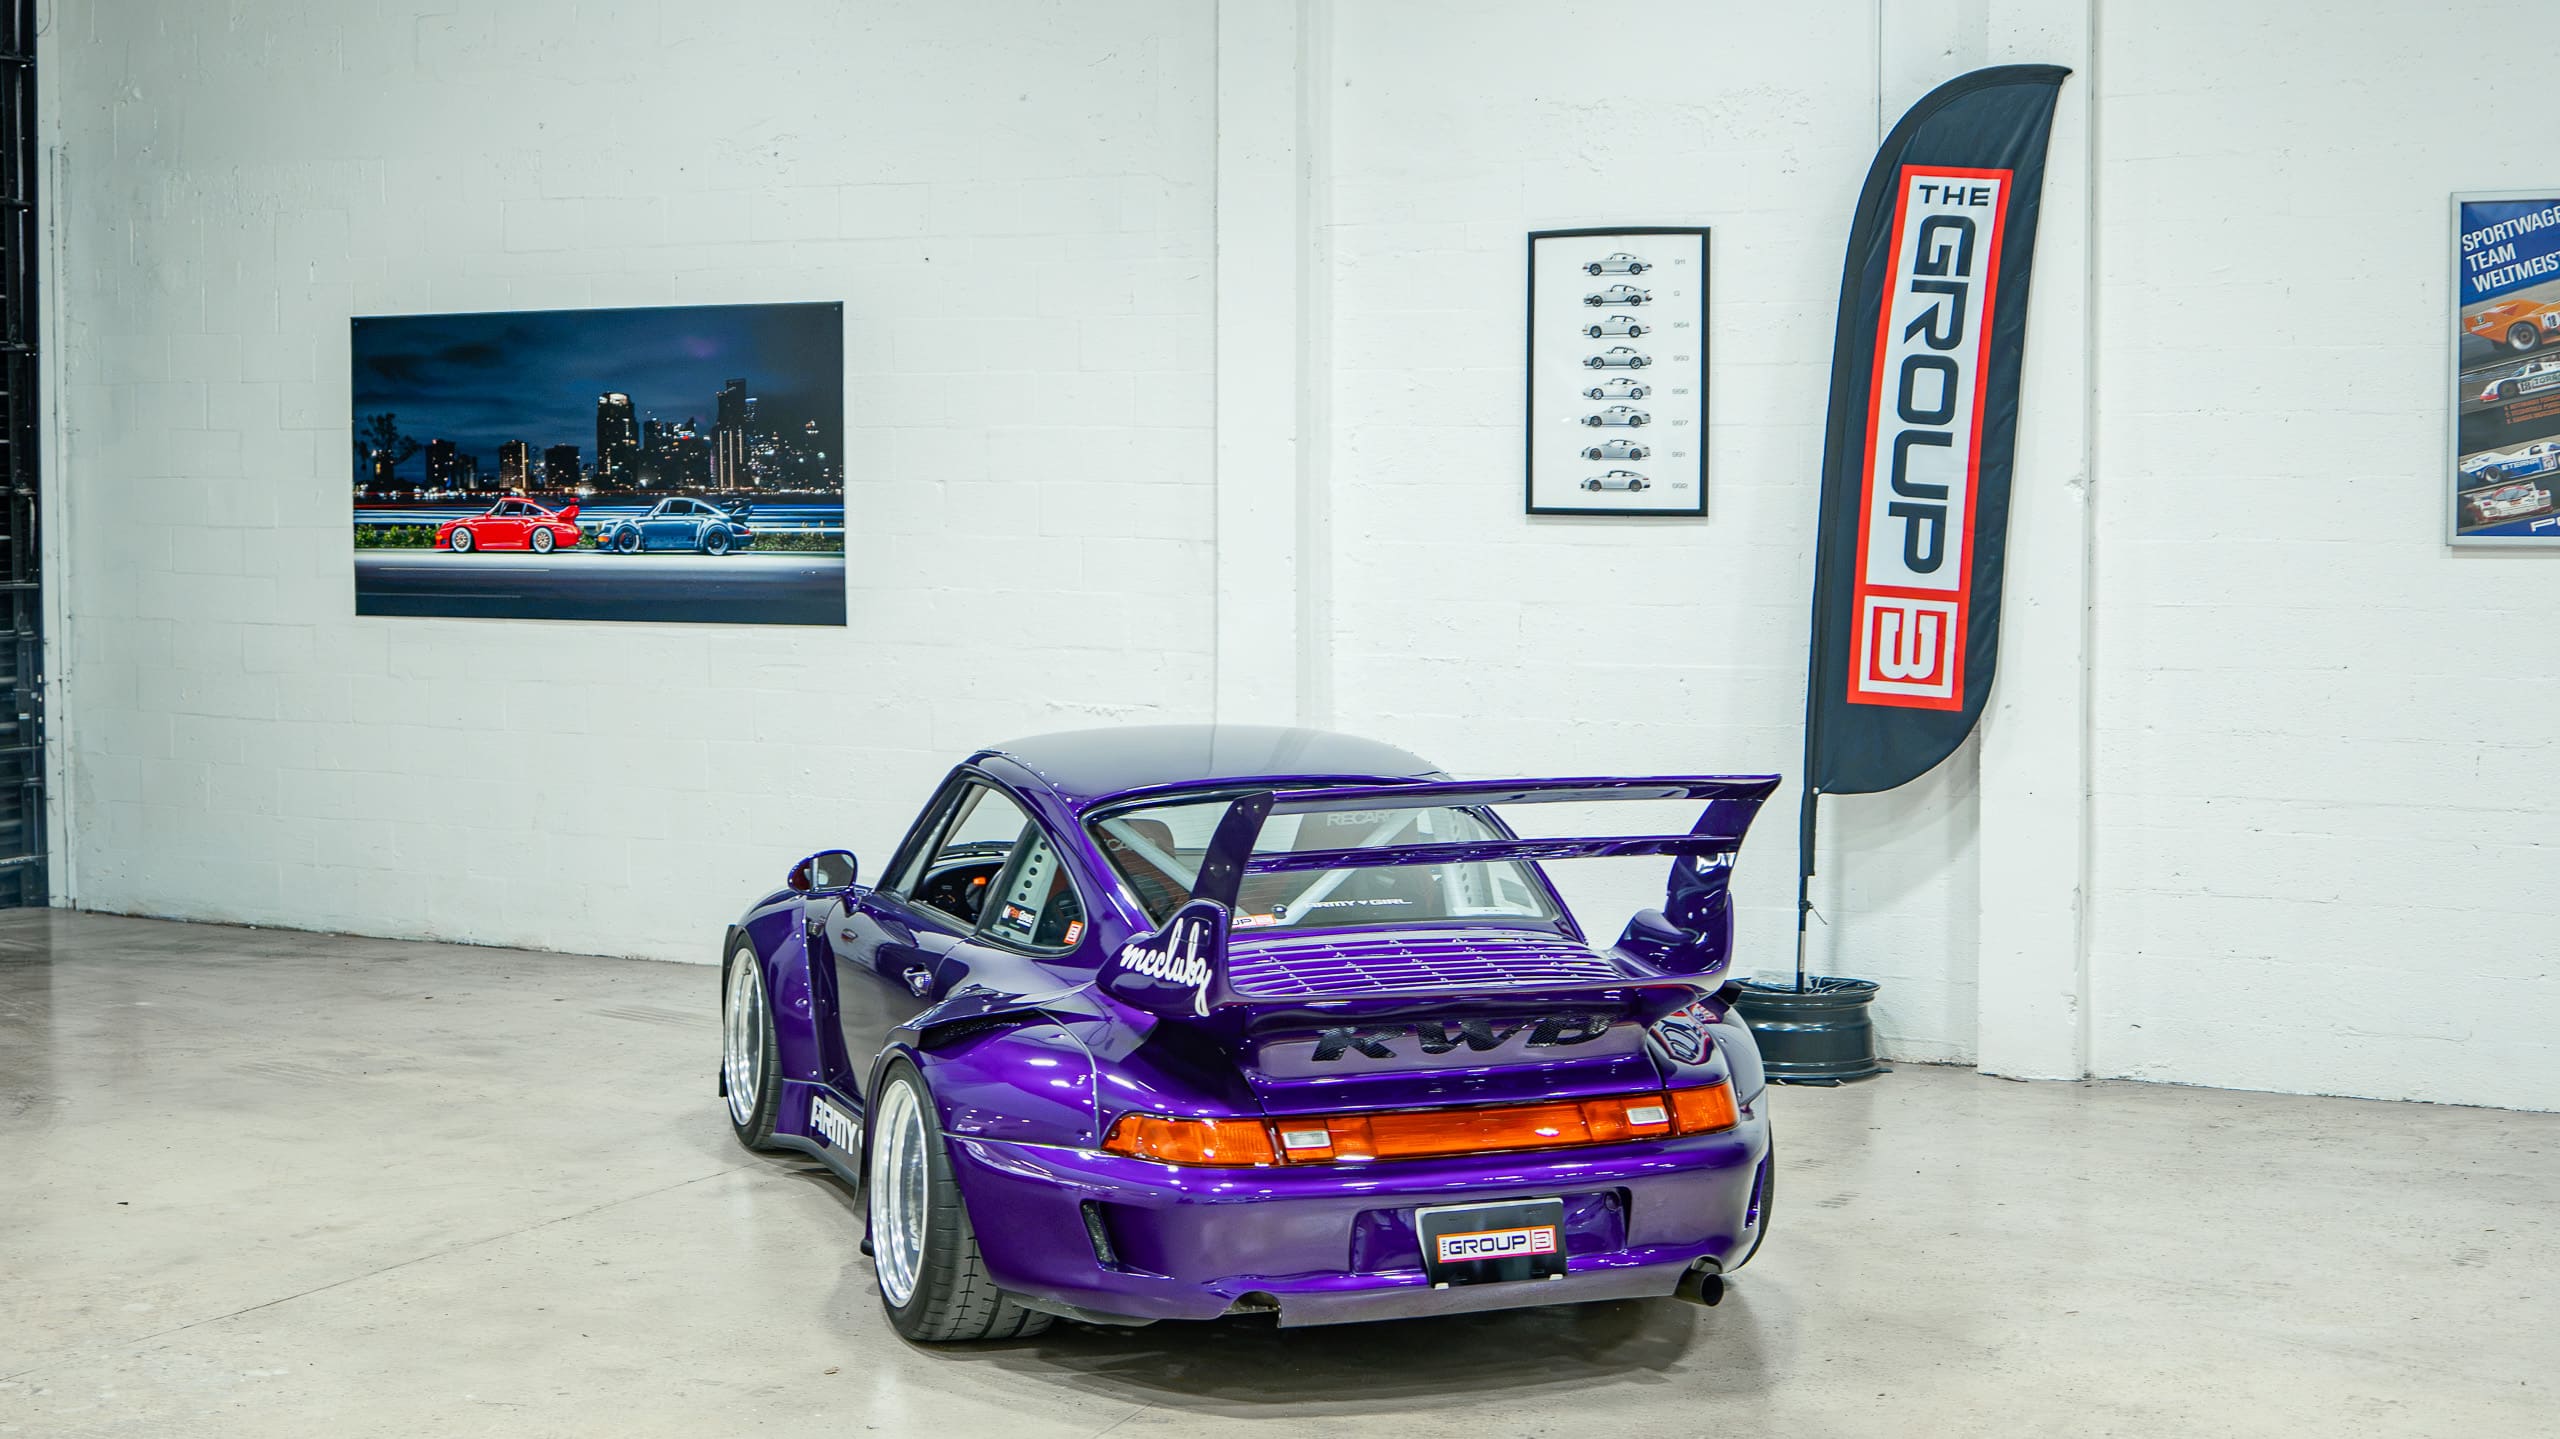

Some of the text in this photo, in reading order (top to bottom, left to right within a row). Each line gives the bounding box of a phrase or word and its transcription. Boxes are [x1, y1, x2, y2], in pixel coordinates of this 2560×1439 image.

[1918, 184, 1991, 206] THE
[2465, 243, 2517, 272] TEAM
[1887, 214, 1977, 575] GROUP
[809, 1095, 858, 1155] ARMY
[1448, 1234, 1527, 1255] GROUP
